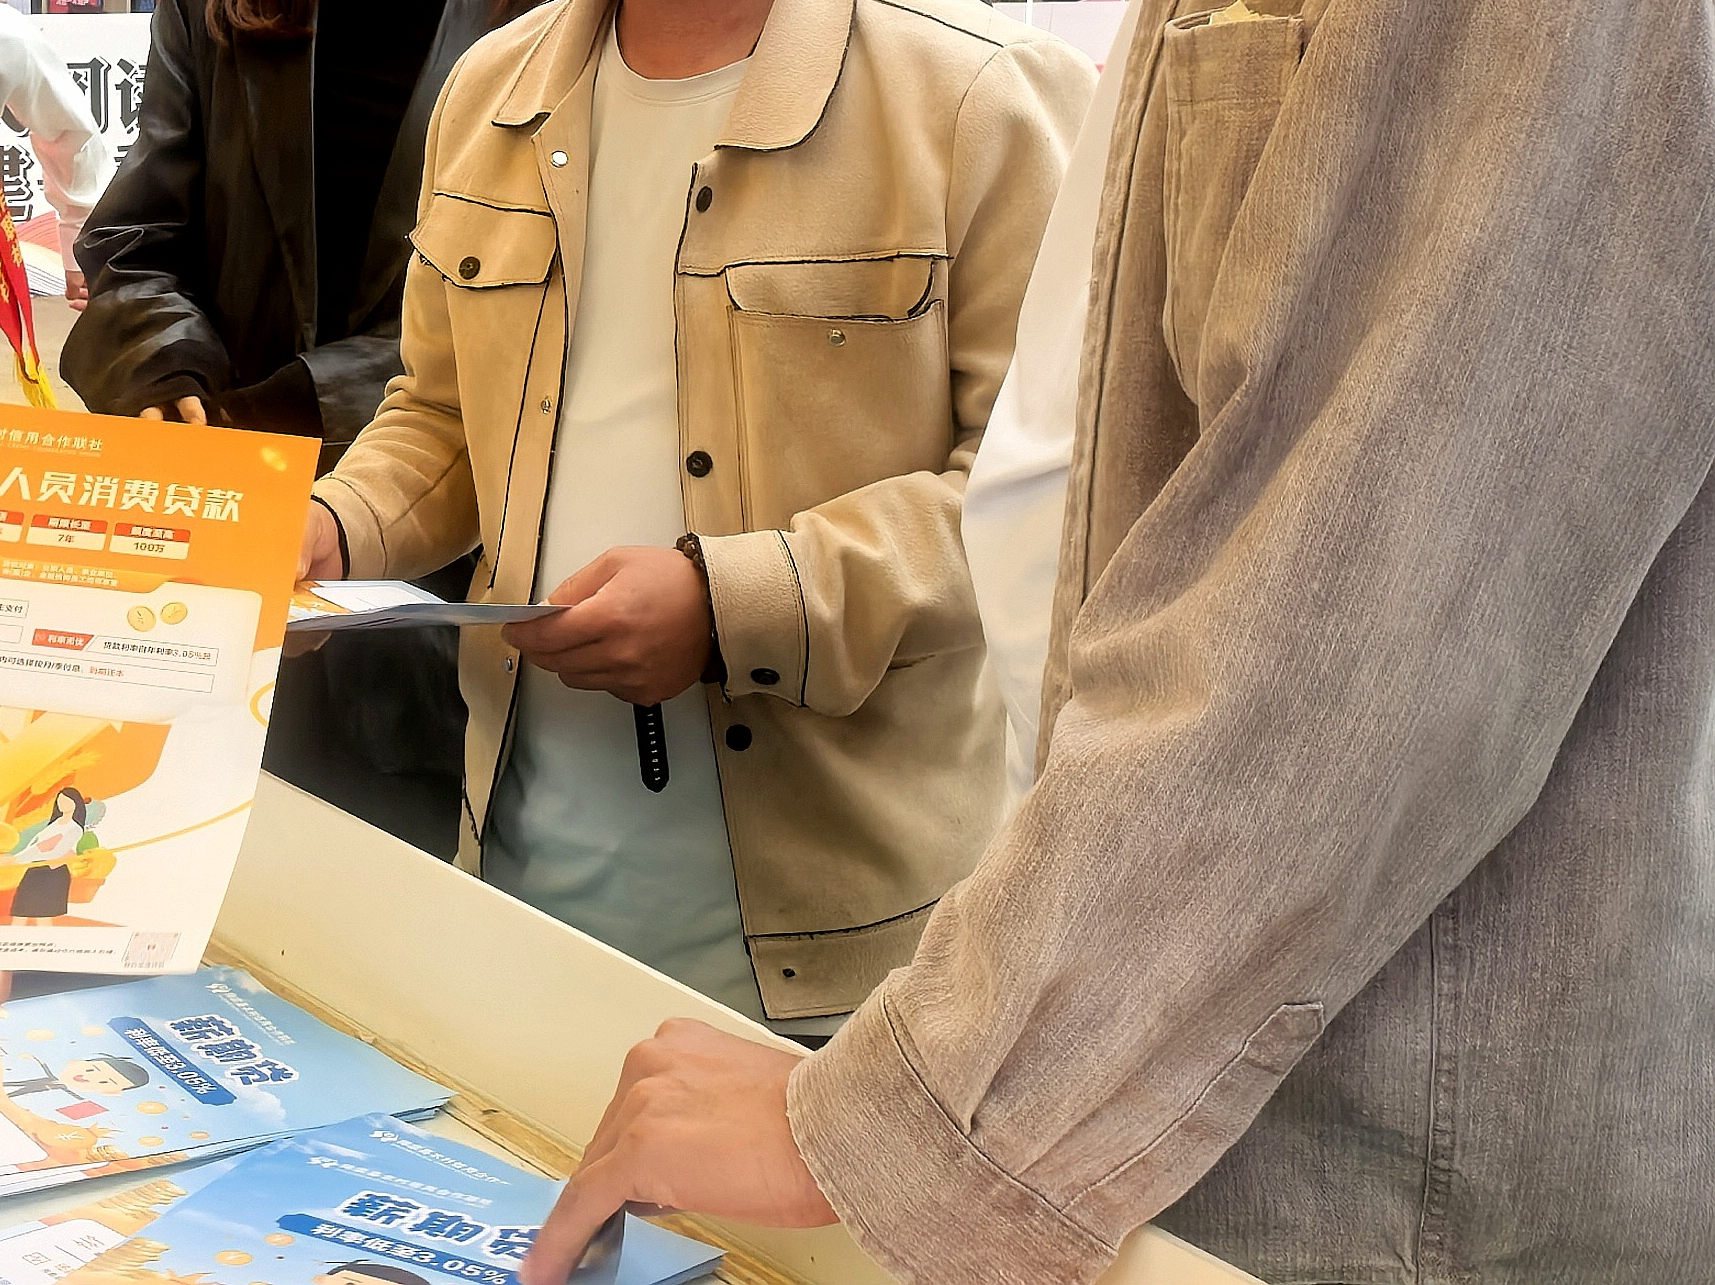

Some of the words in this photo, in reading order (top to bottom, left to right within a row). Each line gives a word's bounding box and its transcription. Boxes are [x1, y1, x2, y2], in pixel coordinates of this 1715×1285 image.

[58, 533, 75, 544] 7年
[134, 542, 166, 553] 100万
[313, 1223, 506, 1284] 利率低至3.05%
